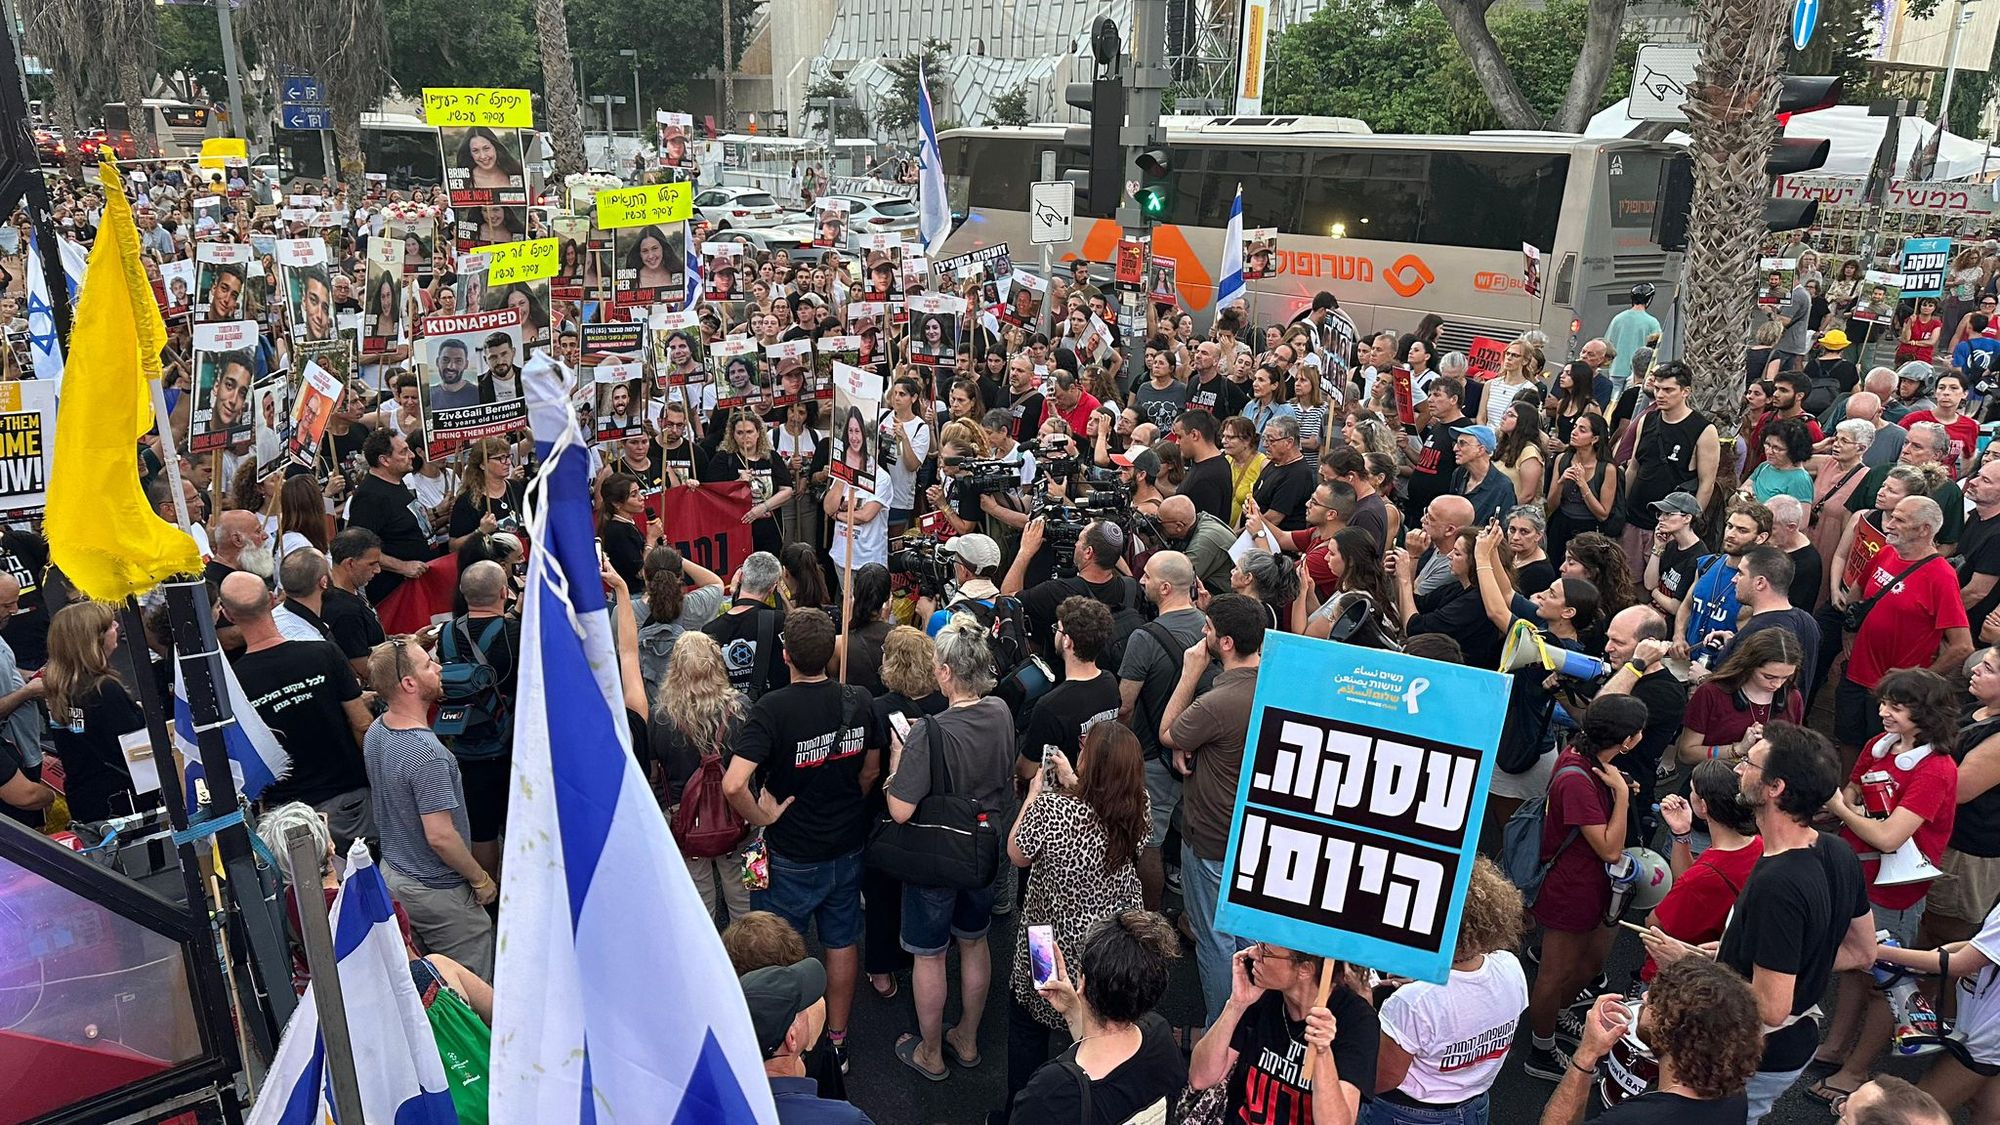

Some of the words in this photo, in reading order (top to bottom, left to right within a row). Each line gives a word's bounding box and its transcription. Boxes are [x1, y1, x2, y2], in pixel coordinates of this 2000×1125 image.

[465, 93, 485, 106] לה
[490, 92, 521, 109] תסתכל
[482, 112, 505, 123] עסקה
[447, 168, 470, 178] BRING
[449, 179, 465, 189] HER
[451, 191, 472, 201] HOME
[652, 206, 673, 218] עסקה
[458, 230, 471, 239] HER
[511, 244, 525, 258] לה
[530, 243, 554, 258] תסתכל
[1276, 250, 1373, 283] מטרופו
[1904, 254, 1945, 271] עסקה.
[521, 264, 539, 277] עסקה
[617, 269, 637, 279] BRING
[617, 280, 630, 290] HER
[1509, 279, 1524, 288] BU
[426, 310, 518, 334] KIDNAPPED
[439, 409, 482, 421] Ziv&Gali
[485, 401, 521, 414] Berman
[455, 418, 476, 427] years
[478, 415, 490, 423] old
[437, 429, 461, 439] BRING
[463, 427, 484, 437] THEM
[486, 424, 506, 434] HOME
[507, 418, 526, 430] NOW!
[0, 430, 41, 458] ME
[0, 457, 42, 493] OW!
[1353, 665, 1378, 678] نساء
[1379, 671, 1404, 682] נשים
[306, 674, 325, 687] לכל
[1368, 680, 1402, 693] עושות
[282, 682, 306, 693] מקום
[291, 692, 313, 704] איתך
[273, 699, 291, 713] מתן
[442, 711, 463, 720] LiveU
[839, 738, 864, 754] החטופ
[1253, 719, 1477, 832] עסקה.
[1236, 813, 1445, 936] היום!
[1478, 1019, 1515, 1046] המשפחות
[1258, 1046, 1299, 1085] הביתה
